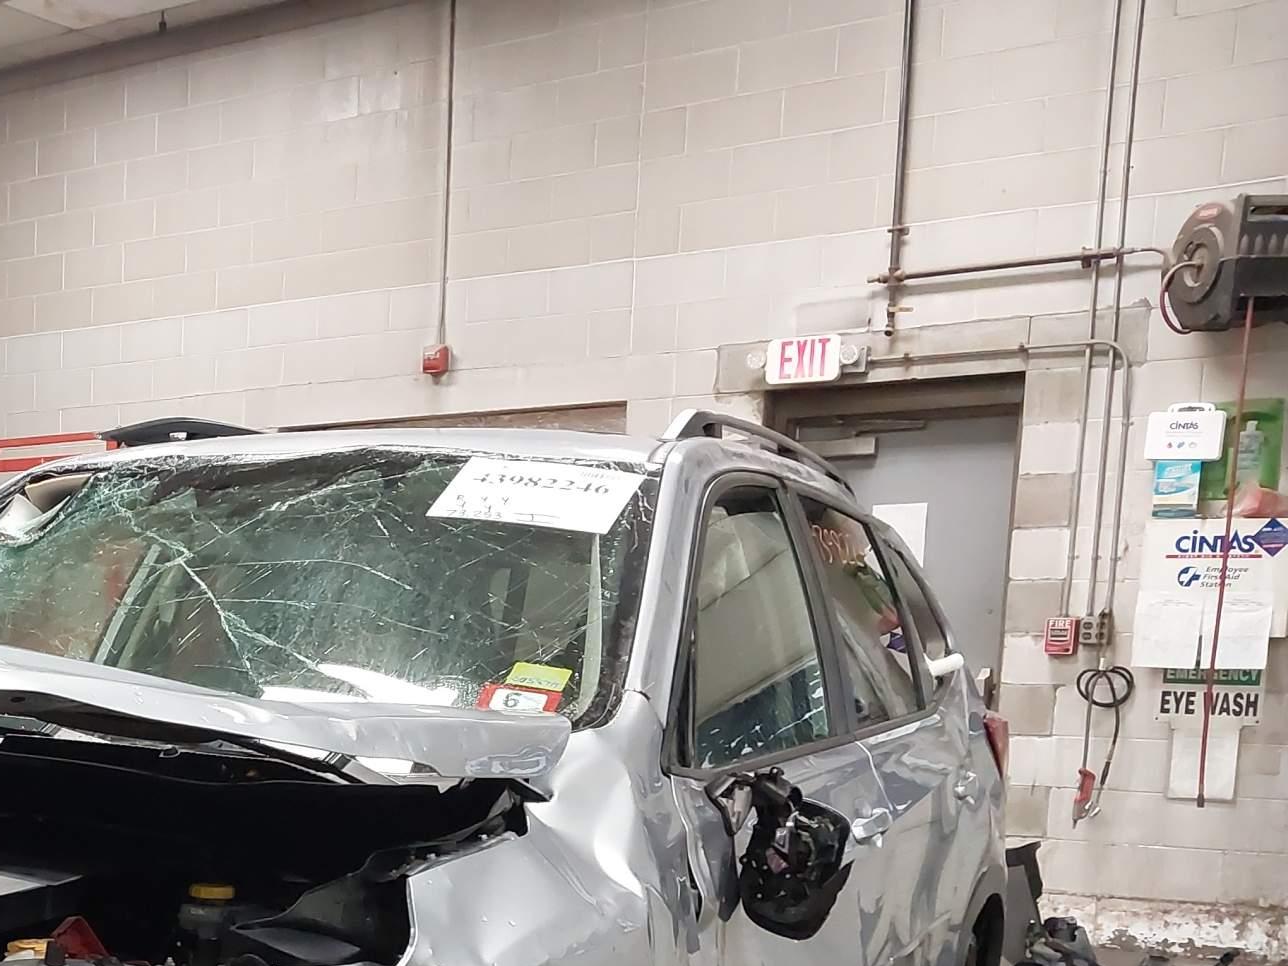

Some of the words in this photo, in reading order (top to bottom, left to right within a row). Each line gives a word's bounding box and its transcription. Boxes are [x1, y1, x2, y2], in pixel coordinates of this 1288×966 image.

[778, 338, 831, 379] EXIT
[473, 472, 611, 495] 43982246
[1175, 529, 1255, 553] CINTAS
[1049, 619, 1071, 628] FIRE
[1160, 691, 1196, 715] EYE
